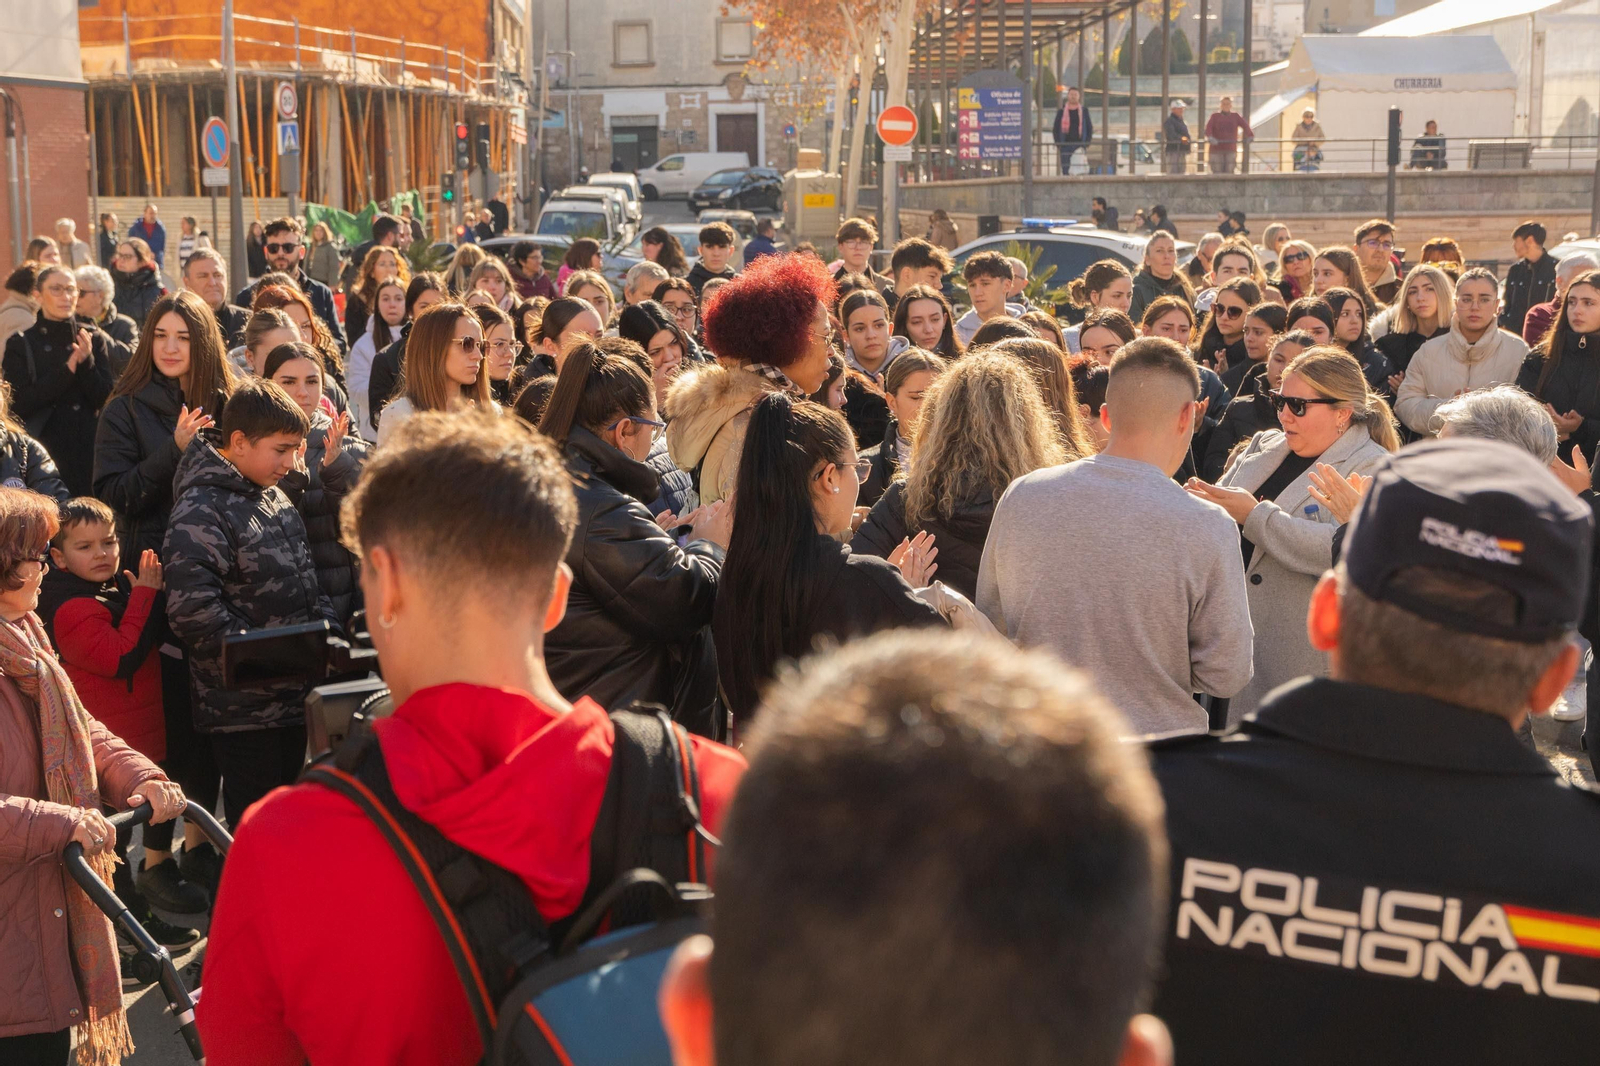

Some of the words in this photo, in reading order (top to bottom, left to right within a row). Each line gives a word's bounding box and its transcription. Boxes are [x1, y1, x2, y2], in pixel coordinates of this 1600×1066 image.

[1394, 77, 1442, 89] CHURRERIA
[1419, 531, 1522, 565] NACIONAL
[1176, 900, 1600, 1002] NACIONAL
